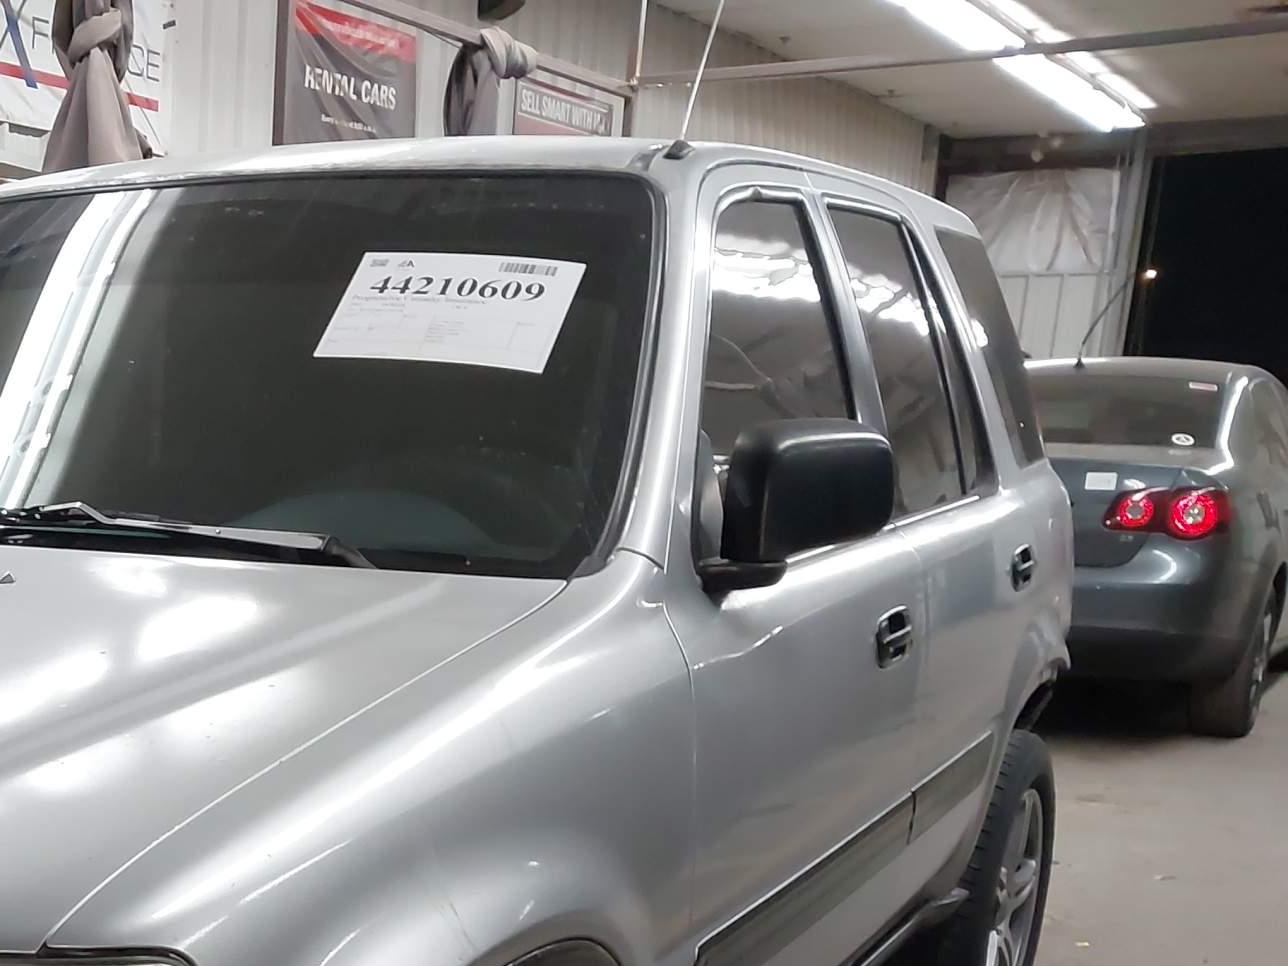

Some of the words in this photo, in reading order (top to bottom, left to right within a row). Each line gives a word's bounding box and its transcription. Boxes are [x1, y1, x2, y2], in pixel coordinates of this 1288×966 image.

[304, 63, 358, 101] RENTAL
[361, 80, 397, 110] CARS
[521, 88, 540, 115] SELL
[541, 95, 571, 123] SMART
[369, 275, 546, 301] 44210609
